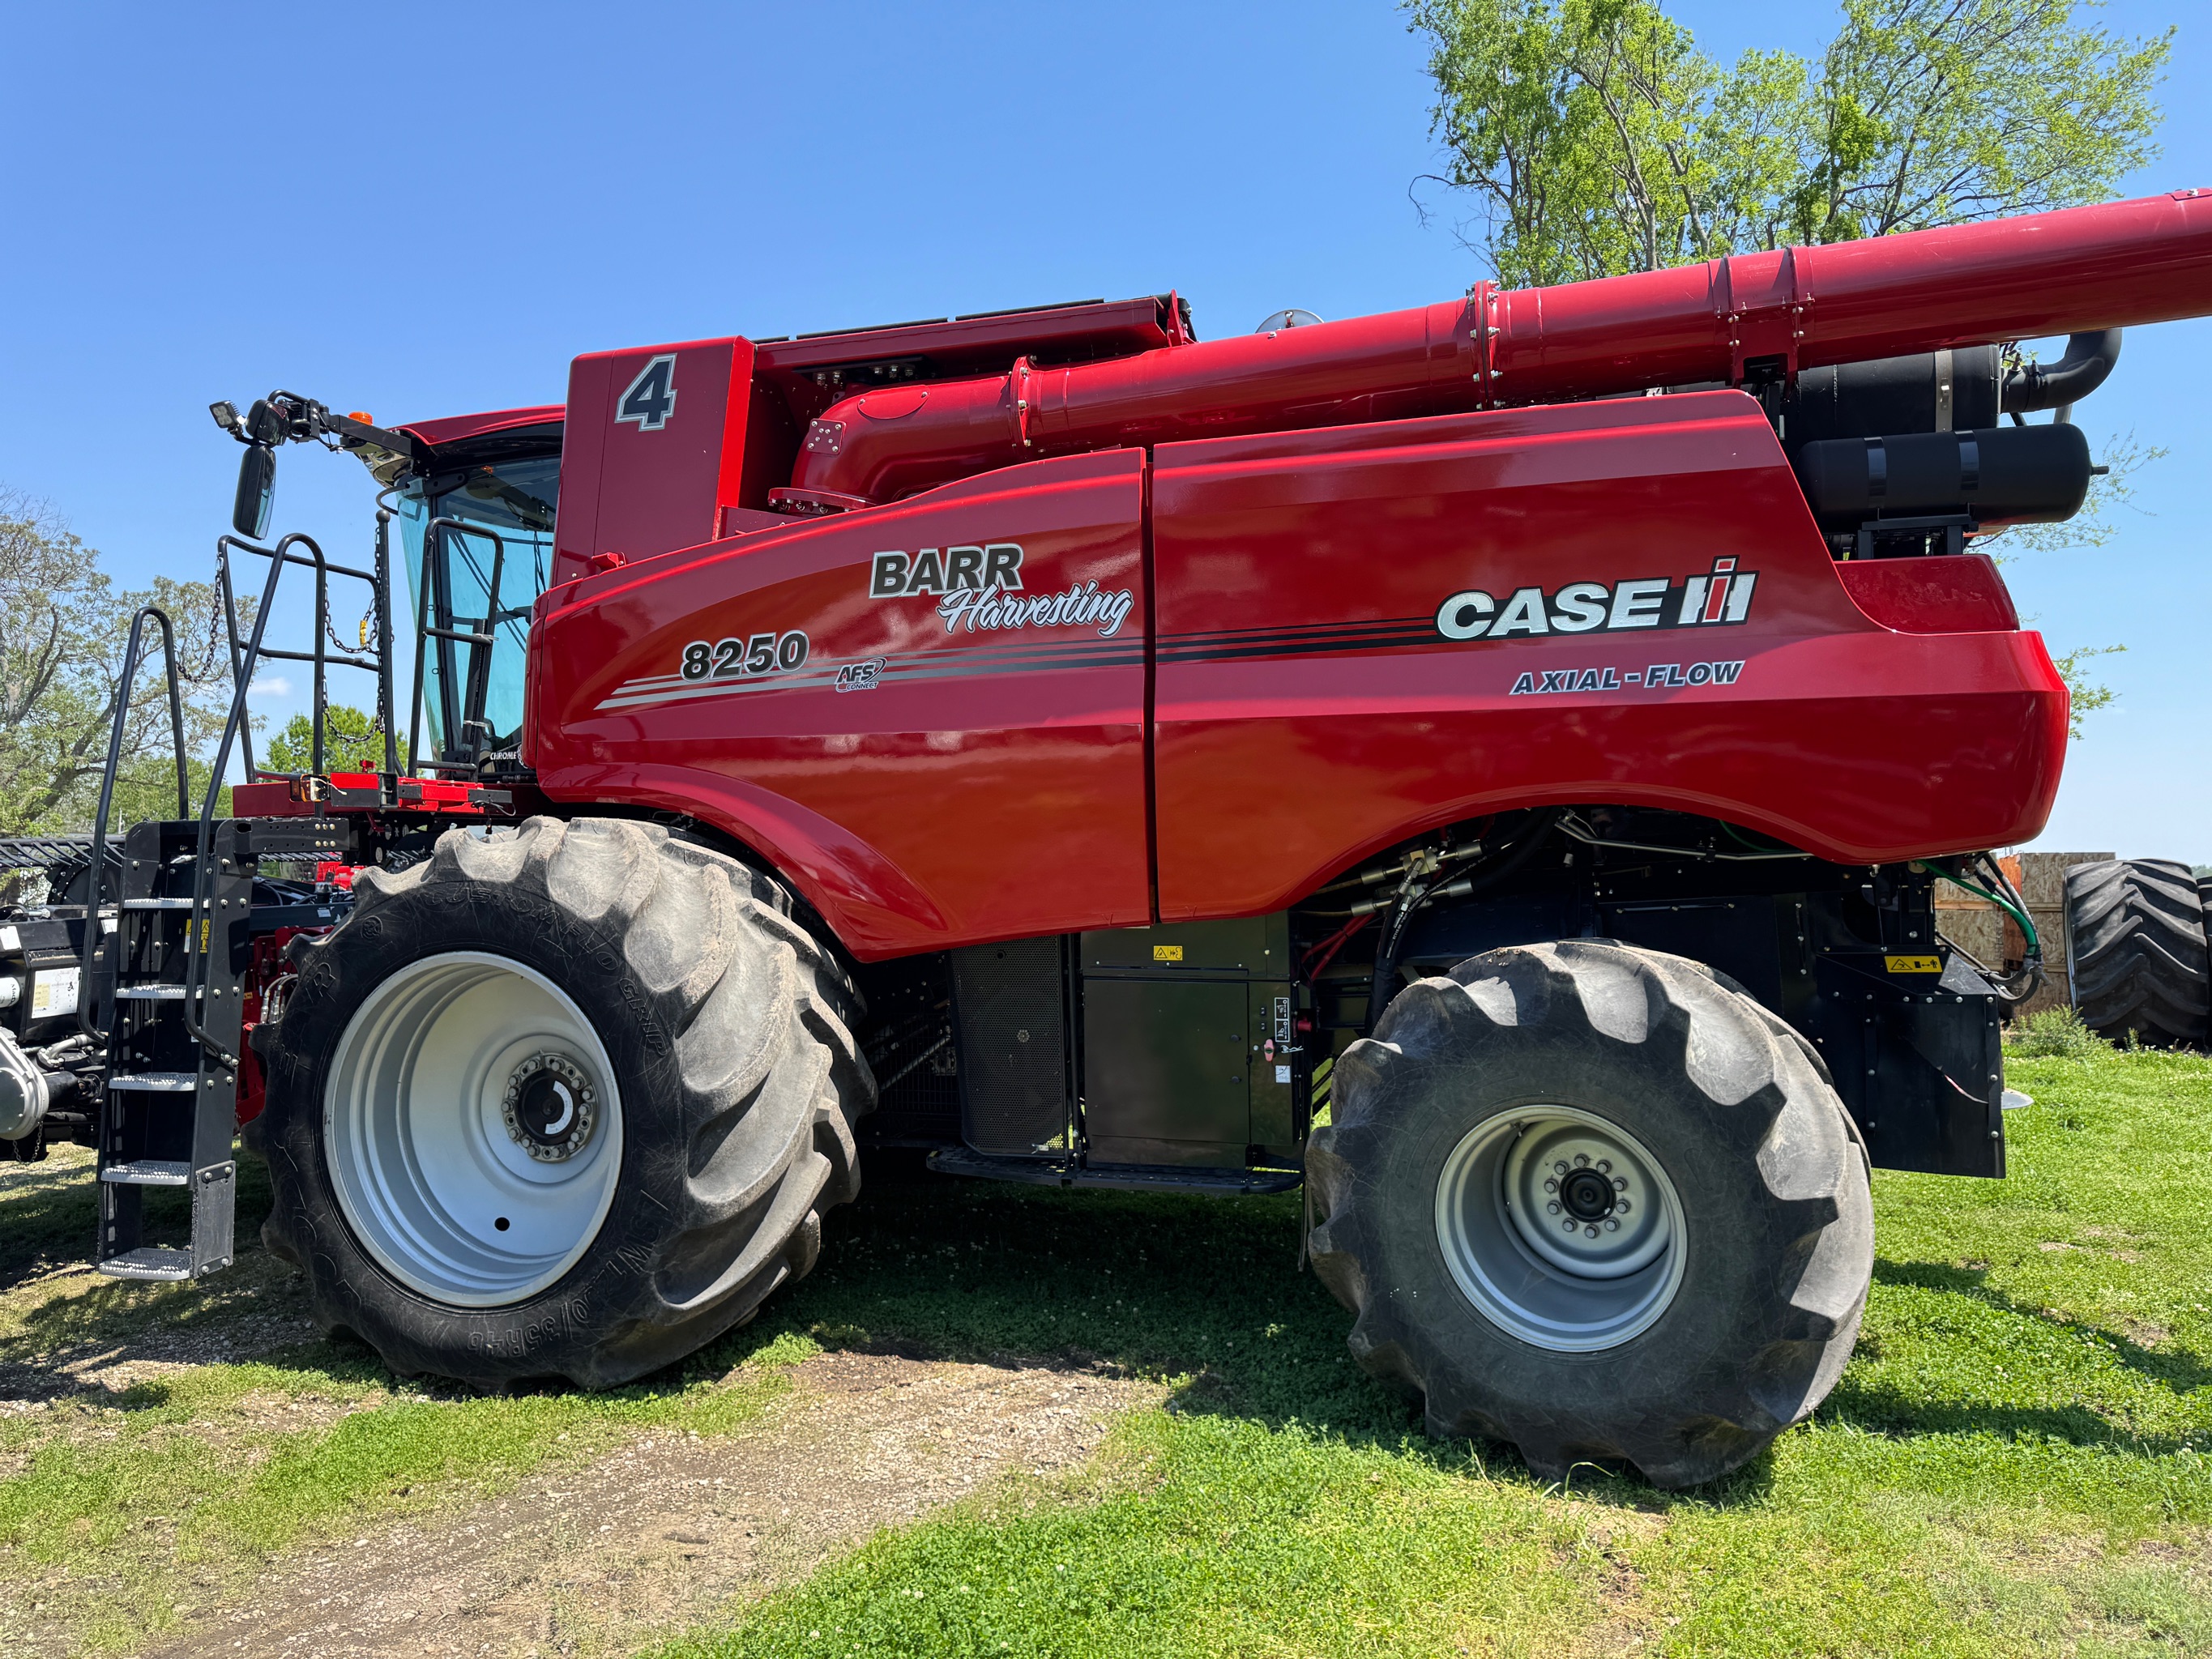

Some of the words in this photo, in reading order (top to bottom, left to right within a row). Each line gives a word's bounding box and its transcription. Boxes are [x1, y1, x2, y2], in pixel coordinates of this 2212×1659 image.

[614, 352, 678, 432] 4
[869, 544, 1024, 599] BARR
[937, 579, 1134, 638] Harvesting
[1437, 579, 1671, 640] CASE
[680, 629, 810, 682] 8250
[835, 662, 878, 684] AFS
[1509, 659, 1746, 696] AXIAL-FLOW
[847, 681, 878, 690] CONNECT
[489, 751, 517, 761] CHROME
[617, 971, 669, 1060] GRIP
